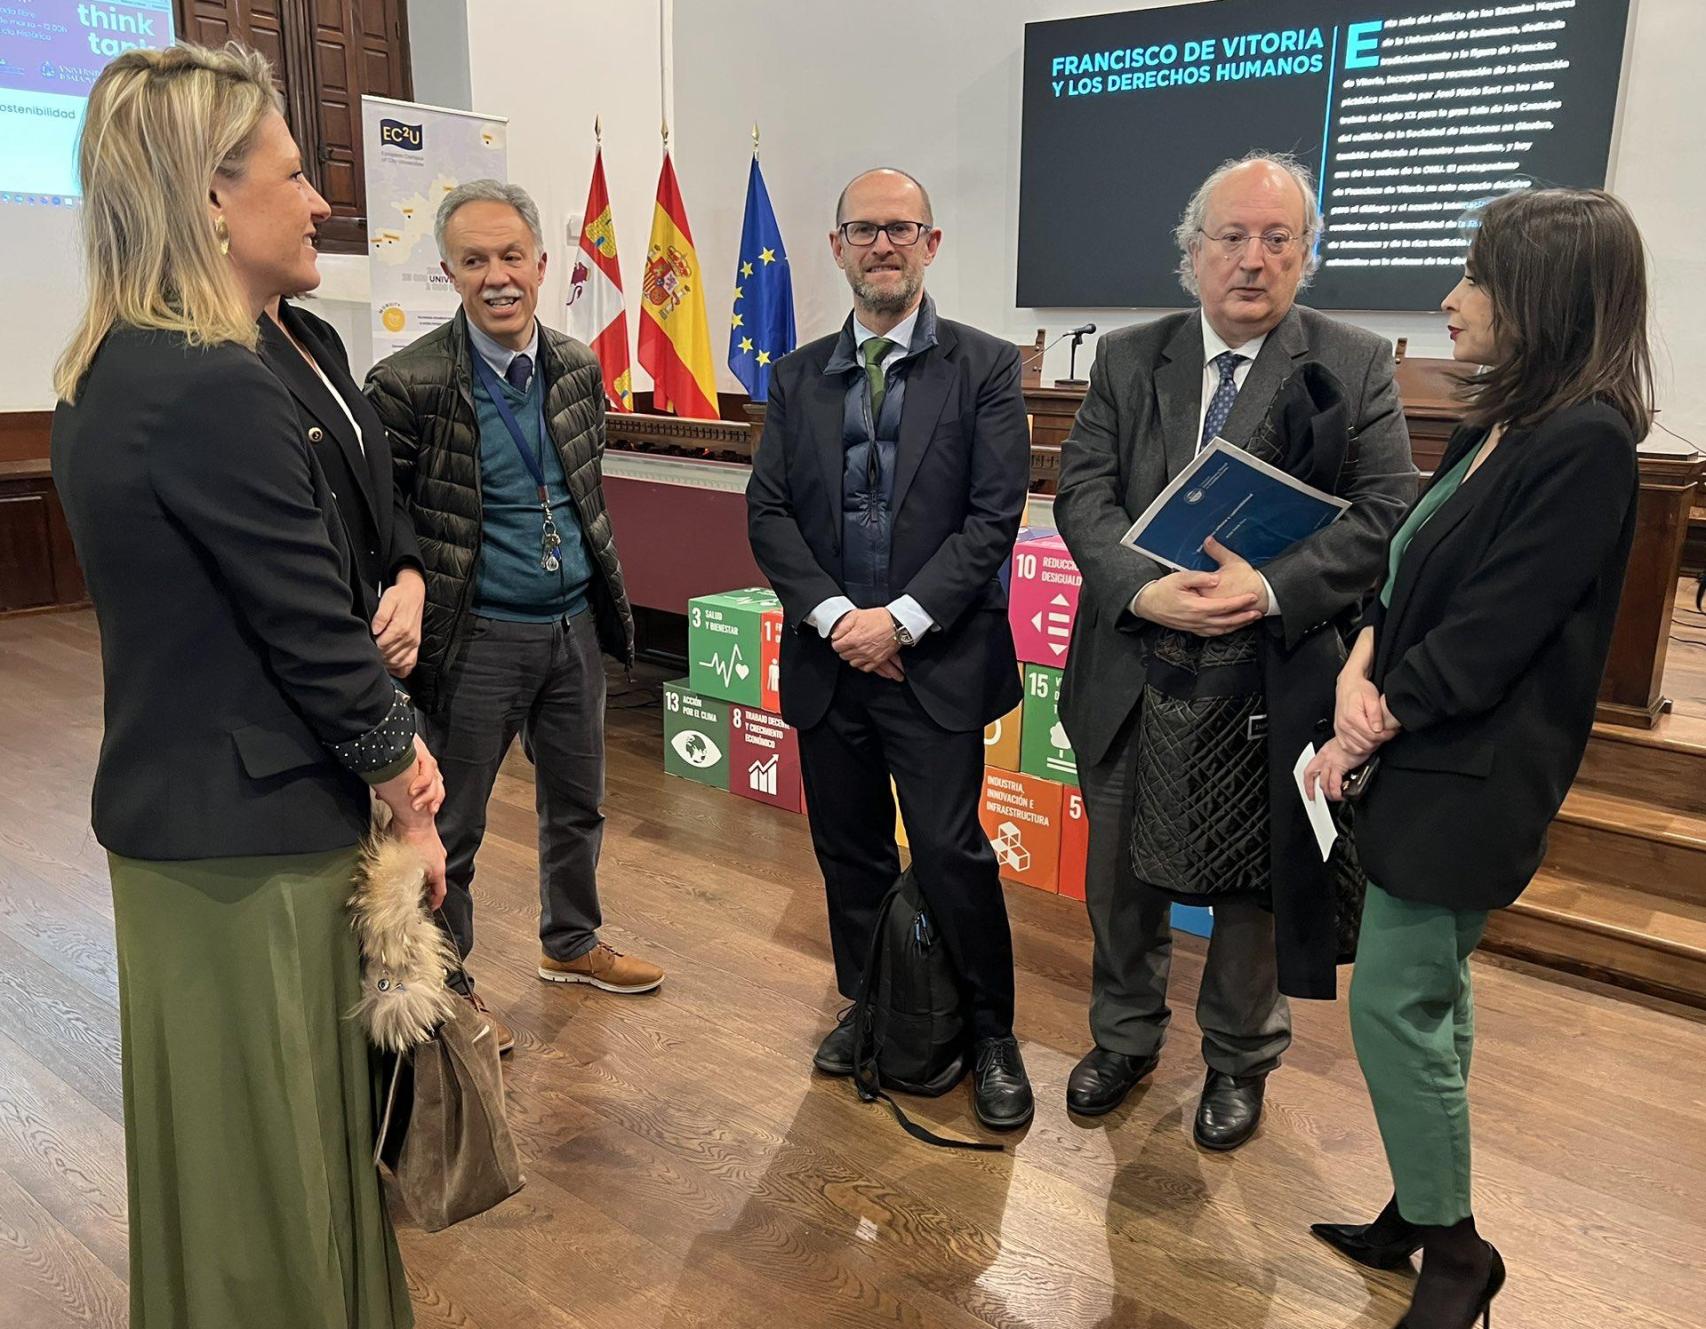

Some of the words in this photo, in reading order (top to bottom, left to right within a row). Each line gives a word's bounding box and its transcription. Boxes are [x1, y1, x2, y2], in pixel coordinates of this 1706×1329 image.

[78, 4, 155, 36] think
[1052, 44, 1178, 77] FRANCISCO
[1184, 39, 1216, 62] DE
[1222, 27, 1324, 58] VITORIA
[1052, 81, 1064, 97] Y
[1068, 76, 1103, 96] LOS
[1107, 65, 1211, 92] DERECHOS
[1216, 54, 1323, 82] HUMANOS
[1016, 554, 1036, 579] 10
[692, 607, 701, 628] 3
[705, 610, 722, 620] SALUD
[710, 622, 738, 635] BIENESTAR
[765, 621, 771, 641] 1
[1029, 673, 1049, 697] 15
[665, 691, 679, 712] 13
[682, 696, 702, 707] ACCIÓN
[682, 707, 694, 716] POR
[694, 709, 700, 718] EL
[701, 711, 718, 722] CLIMA
[733, 708, 742, 728] 8
[986, 788, 1028, 808] INNOVACIÓN
[1069, 795, 1082, 819] 5
[986, 801, 1050, 826] INFRAESTRUCTURA
